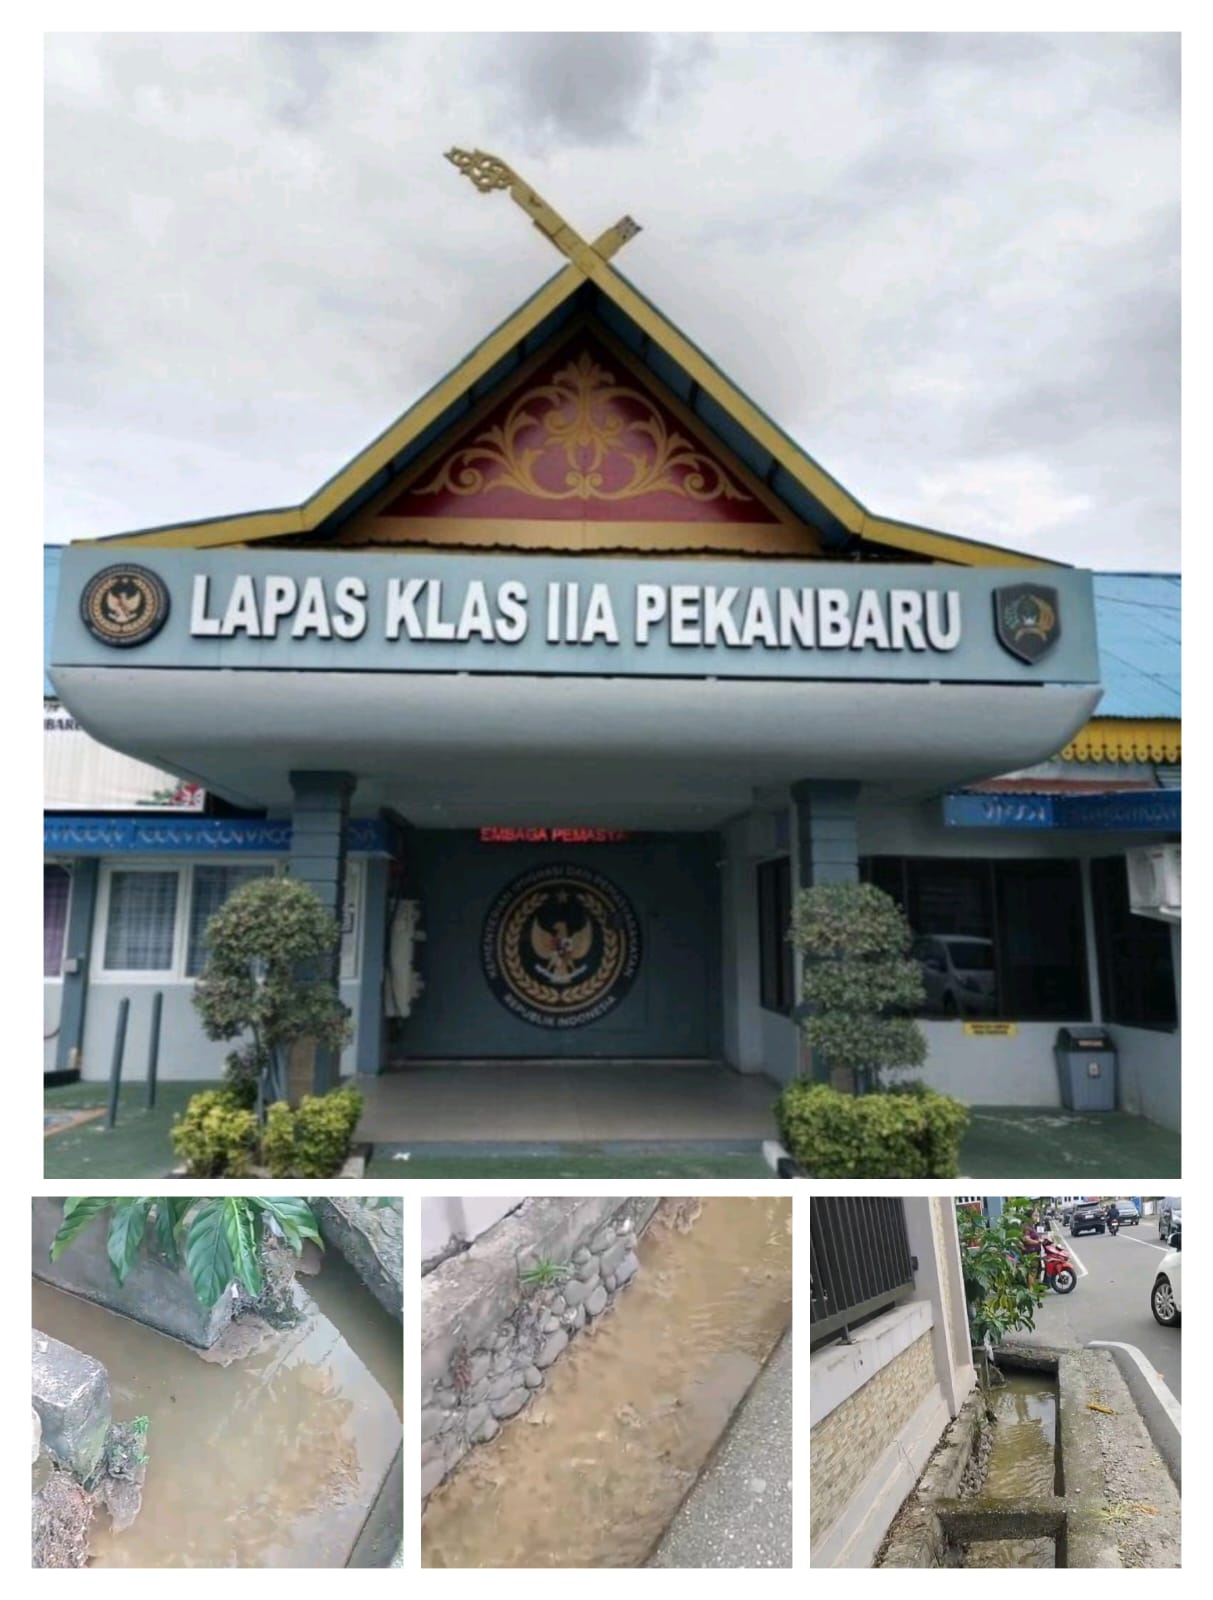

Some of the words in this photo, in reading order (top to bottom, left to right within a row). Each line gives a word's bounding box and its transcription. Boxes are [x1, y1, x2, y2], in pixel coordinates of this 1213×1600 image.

[190, 574, 367, 640] LAPAS
[385, 578, 528, 643] KLAS
[546, 581, 619, 645] IIA
[635, 583, 962, 652] PEKANBARU
[480, 826, 547, 842] EMBAGA
[503, 993, 554, 1025] REPUBLIK
[557, 995, 618, 1026] INDONESIA
